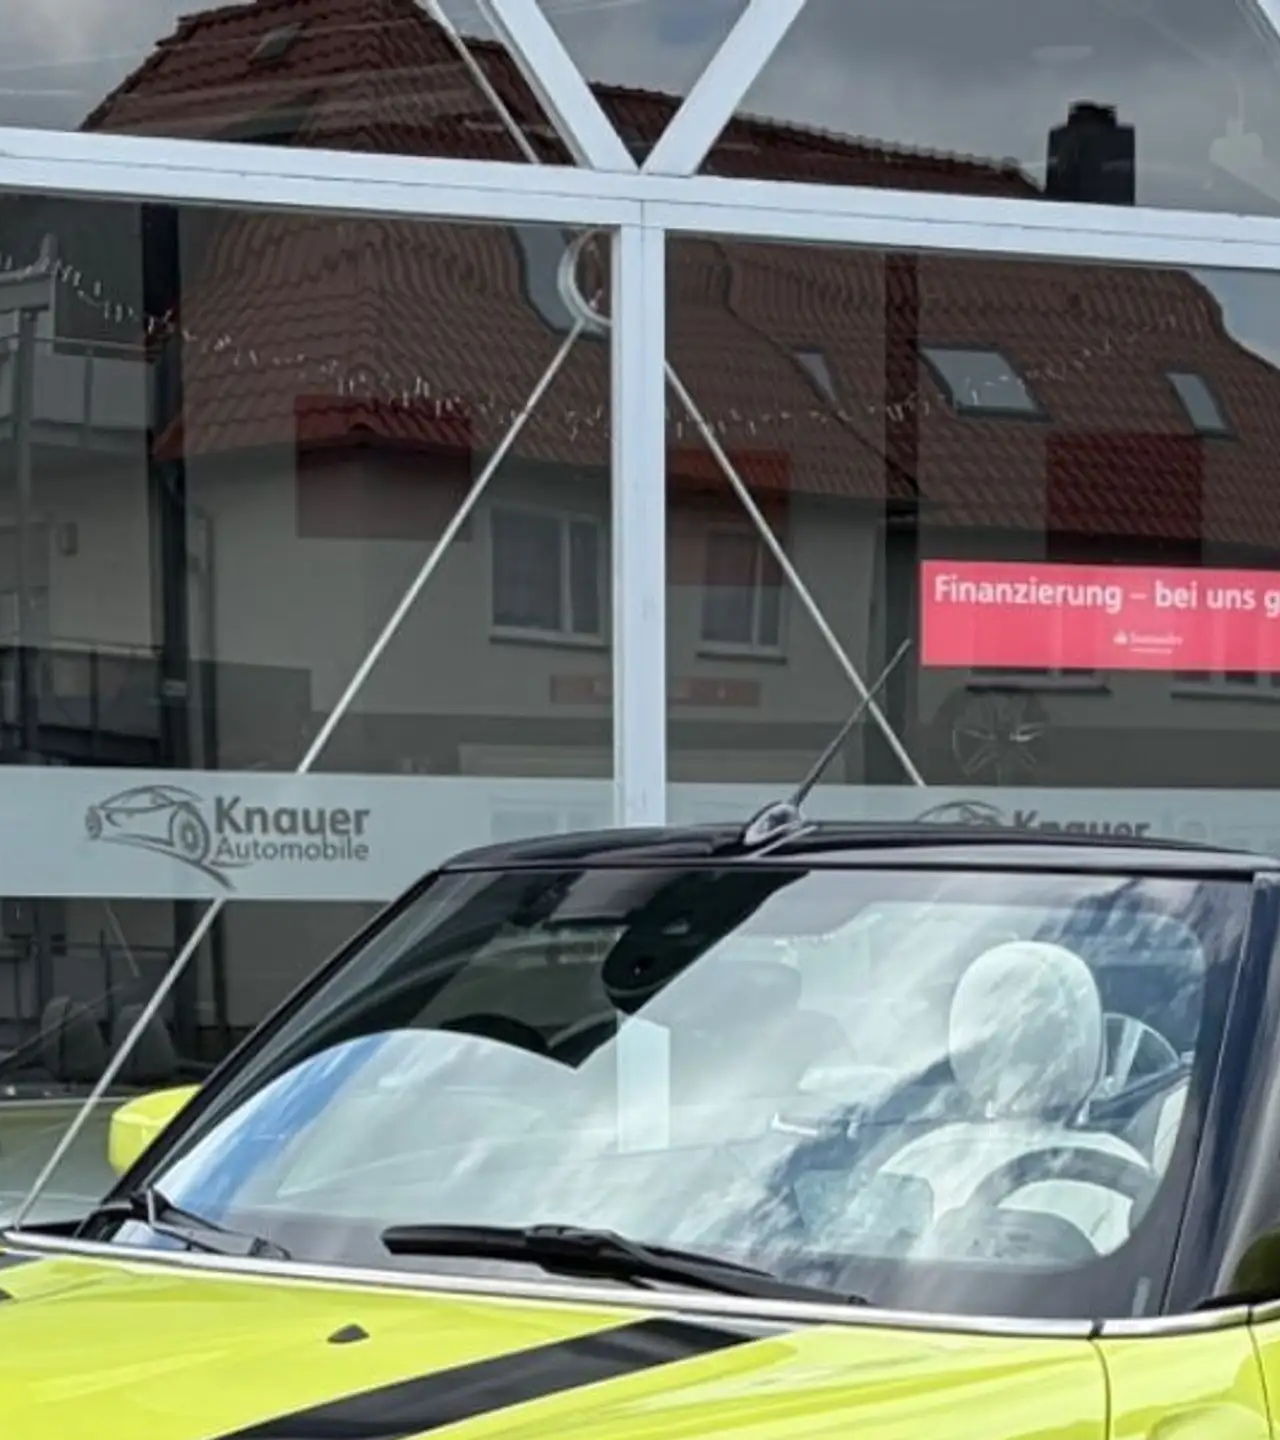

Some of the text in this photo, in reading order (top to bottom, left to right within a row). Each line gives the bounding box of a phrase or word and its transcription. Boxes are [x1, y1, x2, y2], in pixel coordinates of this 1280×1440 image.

[935, 574, 1122, 615] Finanzierung
[1155, 580, 1198, 610] bei
[1206, 588, 1257, 610] uns
[215, 796, 371, 836] Knauer
[215, 836, 370, 862] Automobile
